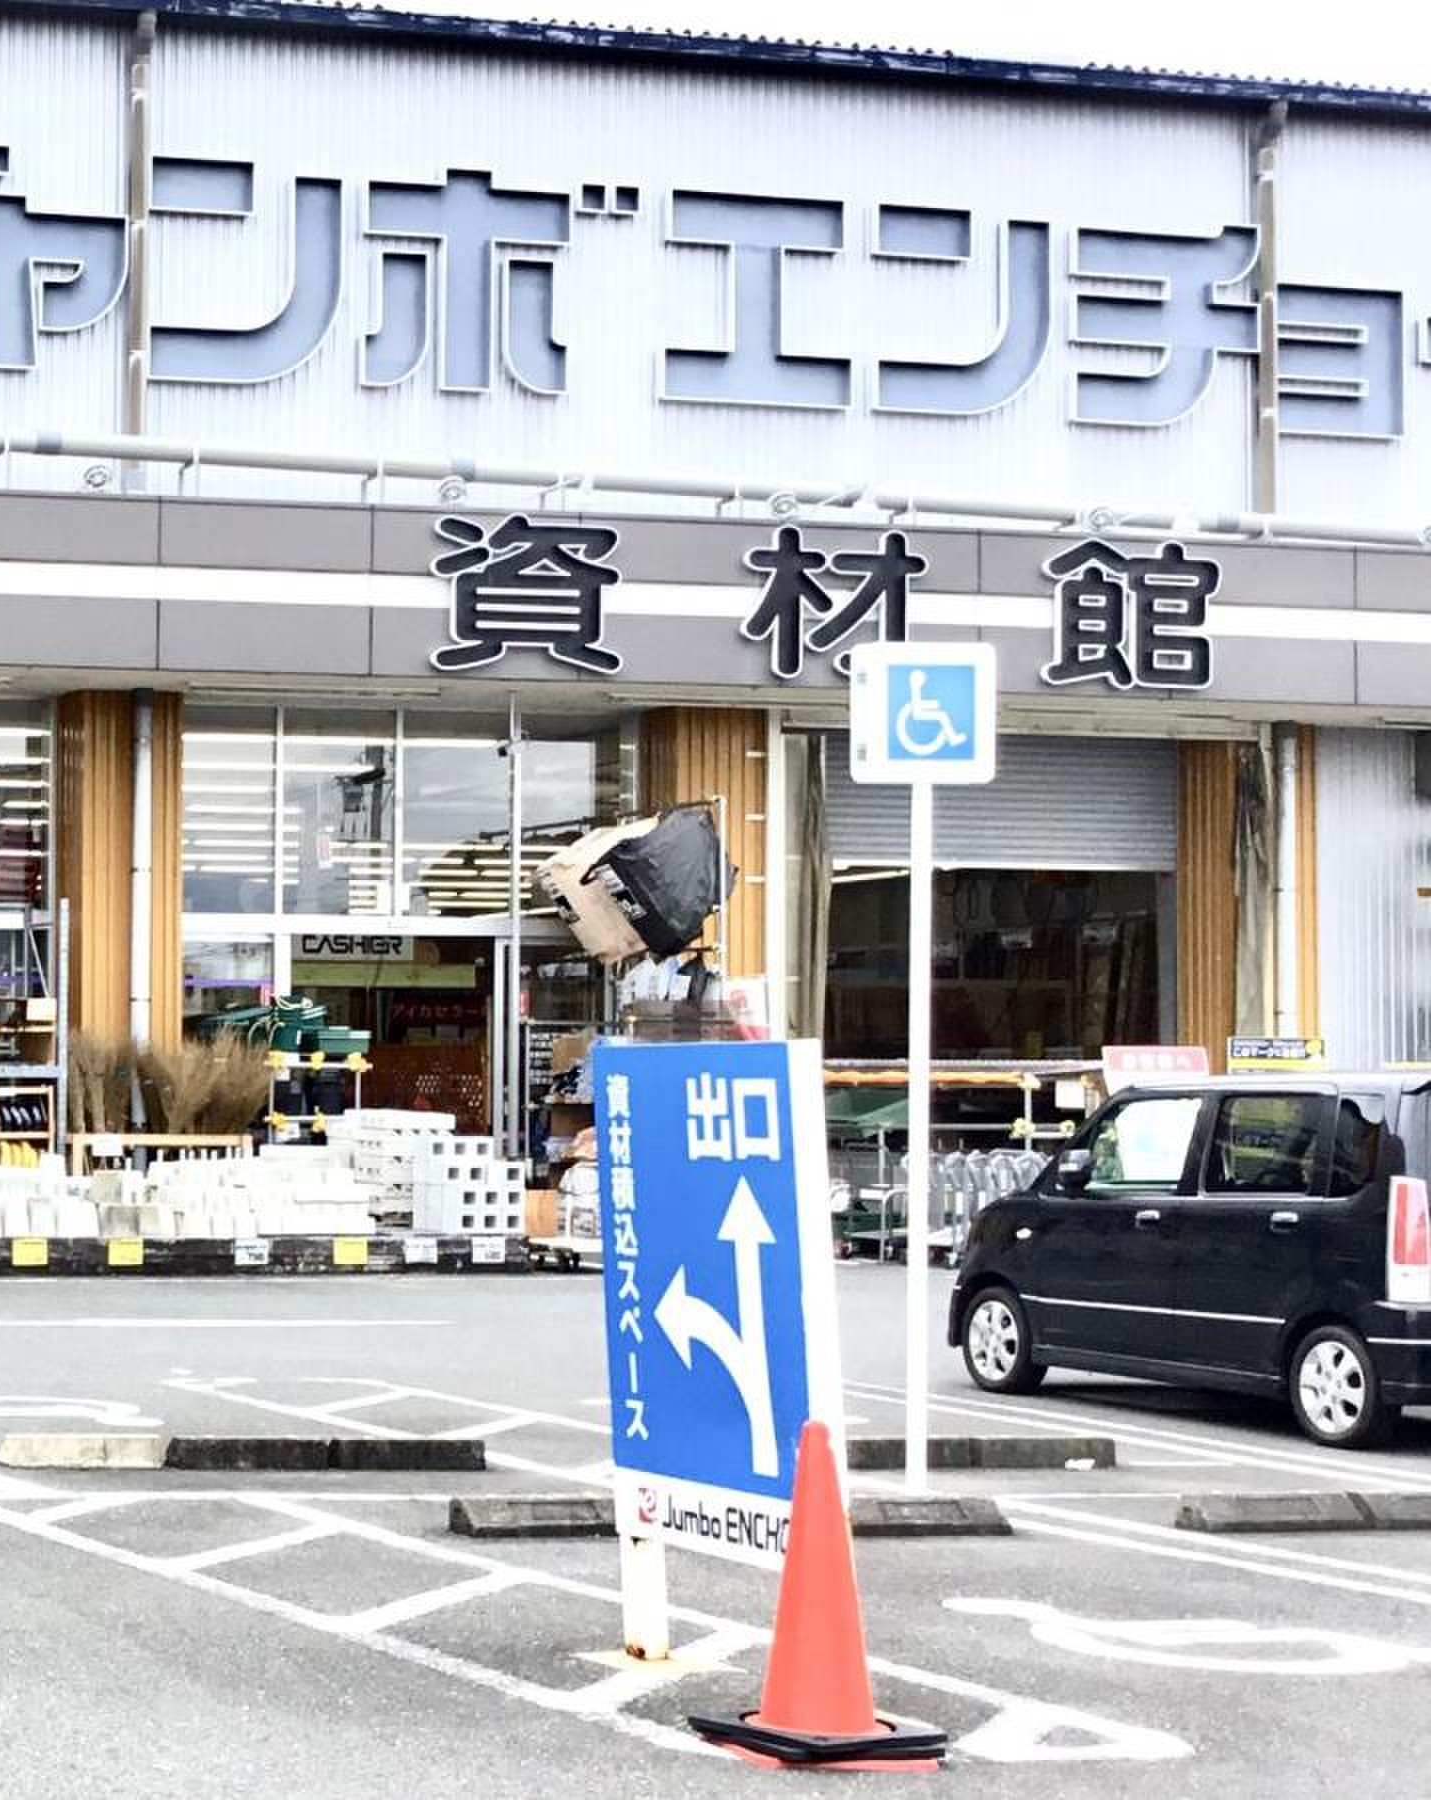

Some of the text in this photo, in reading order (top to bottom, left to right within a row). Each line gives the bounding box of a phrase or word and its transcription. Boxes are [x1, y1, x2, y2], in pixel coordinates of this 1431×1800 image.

[429, 514, 1223, 692] 資材館
[302, 934, 403, 955] CASHIER
[686, 1072, 781, 1161] 出口
[606, 1073, 649, 1440] 資材積込スペース
[662, 1493, 722, 1540] Jumbo
